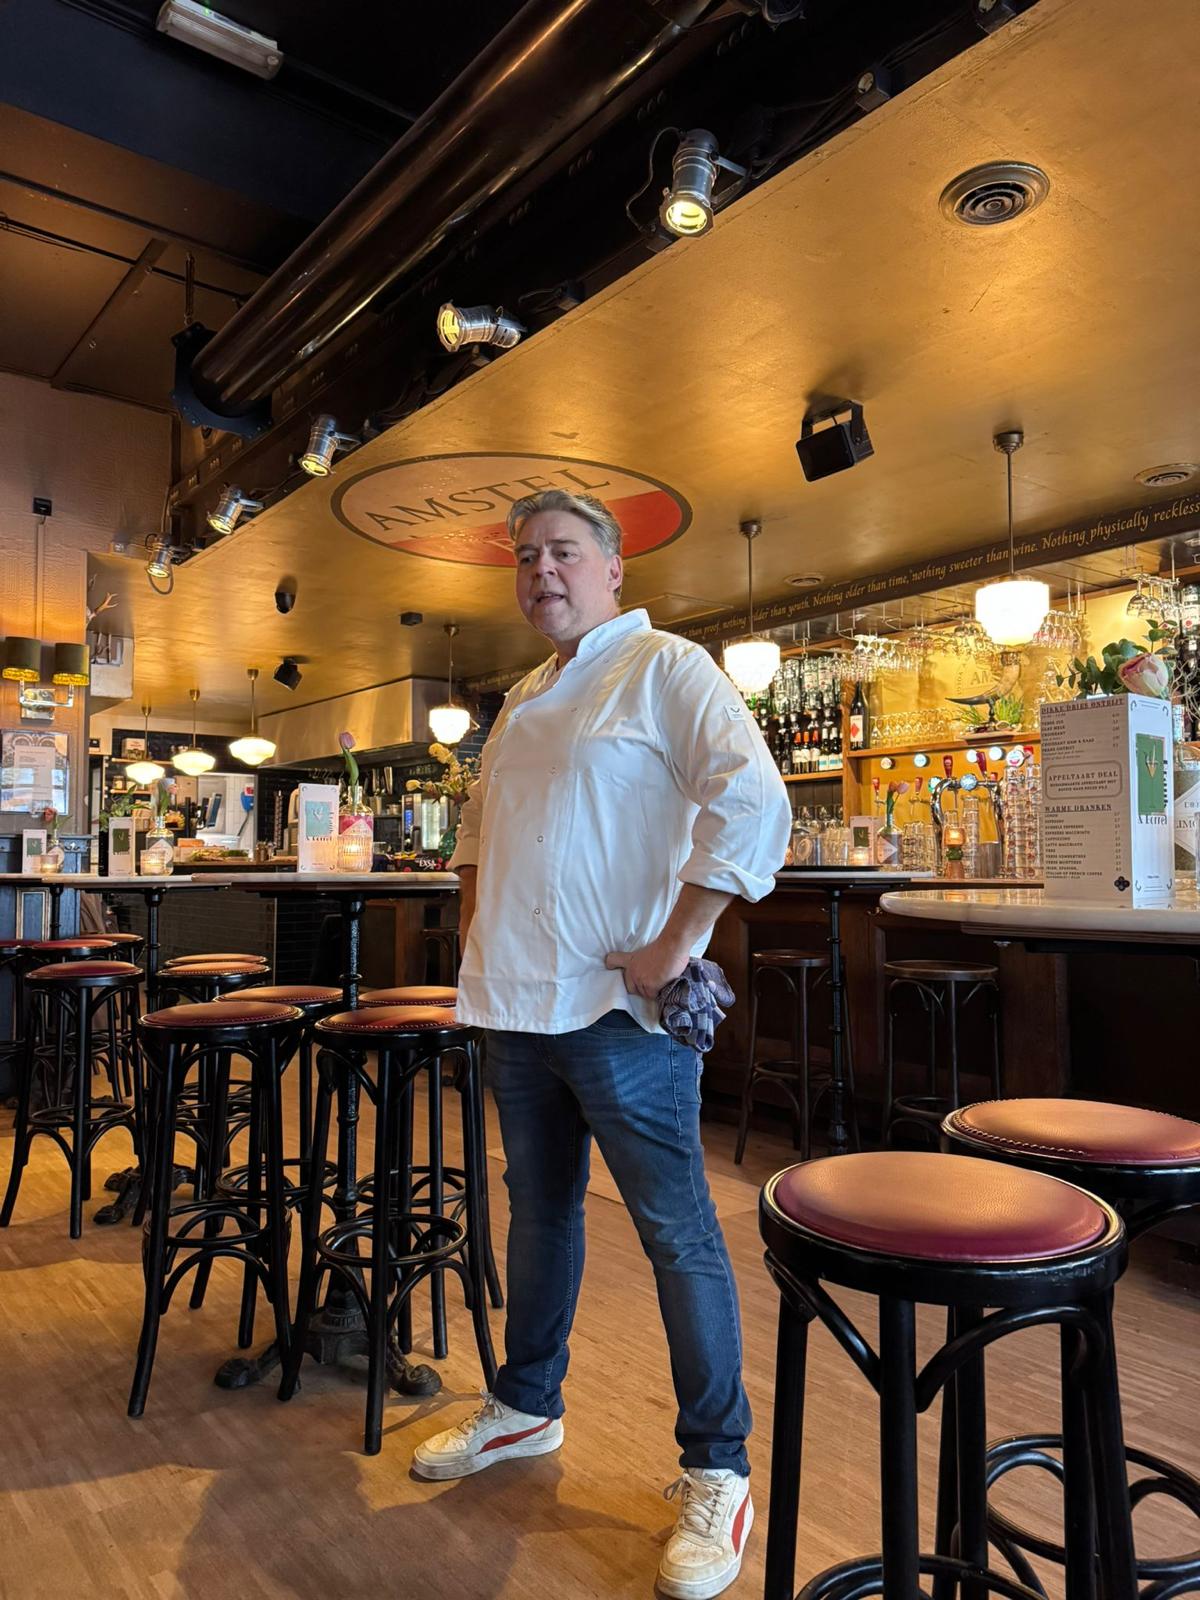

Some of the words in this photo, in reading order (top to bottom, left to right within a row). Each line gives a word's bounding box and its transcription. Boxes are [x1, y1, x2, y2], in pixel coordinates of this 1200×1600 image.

[364, 468, 612, 531] AMSTEL
[722, 615, 747, 631] nothing
[770, 604, 787, 616] than
[812, 590, 844, 607] Nothing
[845, 584, 866, 599] older
[867, 580, 887, 593] than
[912, 563, 947, 580] nothing
[948, 554, 983, 573] sweeter
[986, 547, 1009, 563] than
[1041, 531, 1087, 550] Nothing
[1089, 510, 1149, 542] physically
[1153, 499, 1200, 522] reckless
[1048, 772, 1096, 782] APPELTAART
[1097, 770, 1119, 778] DEAL
[1044, 805, 1073, 813] WARME
[1074, 803, 1112, 812] DRANKEN
